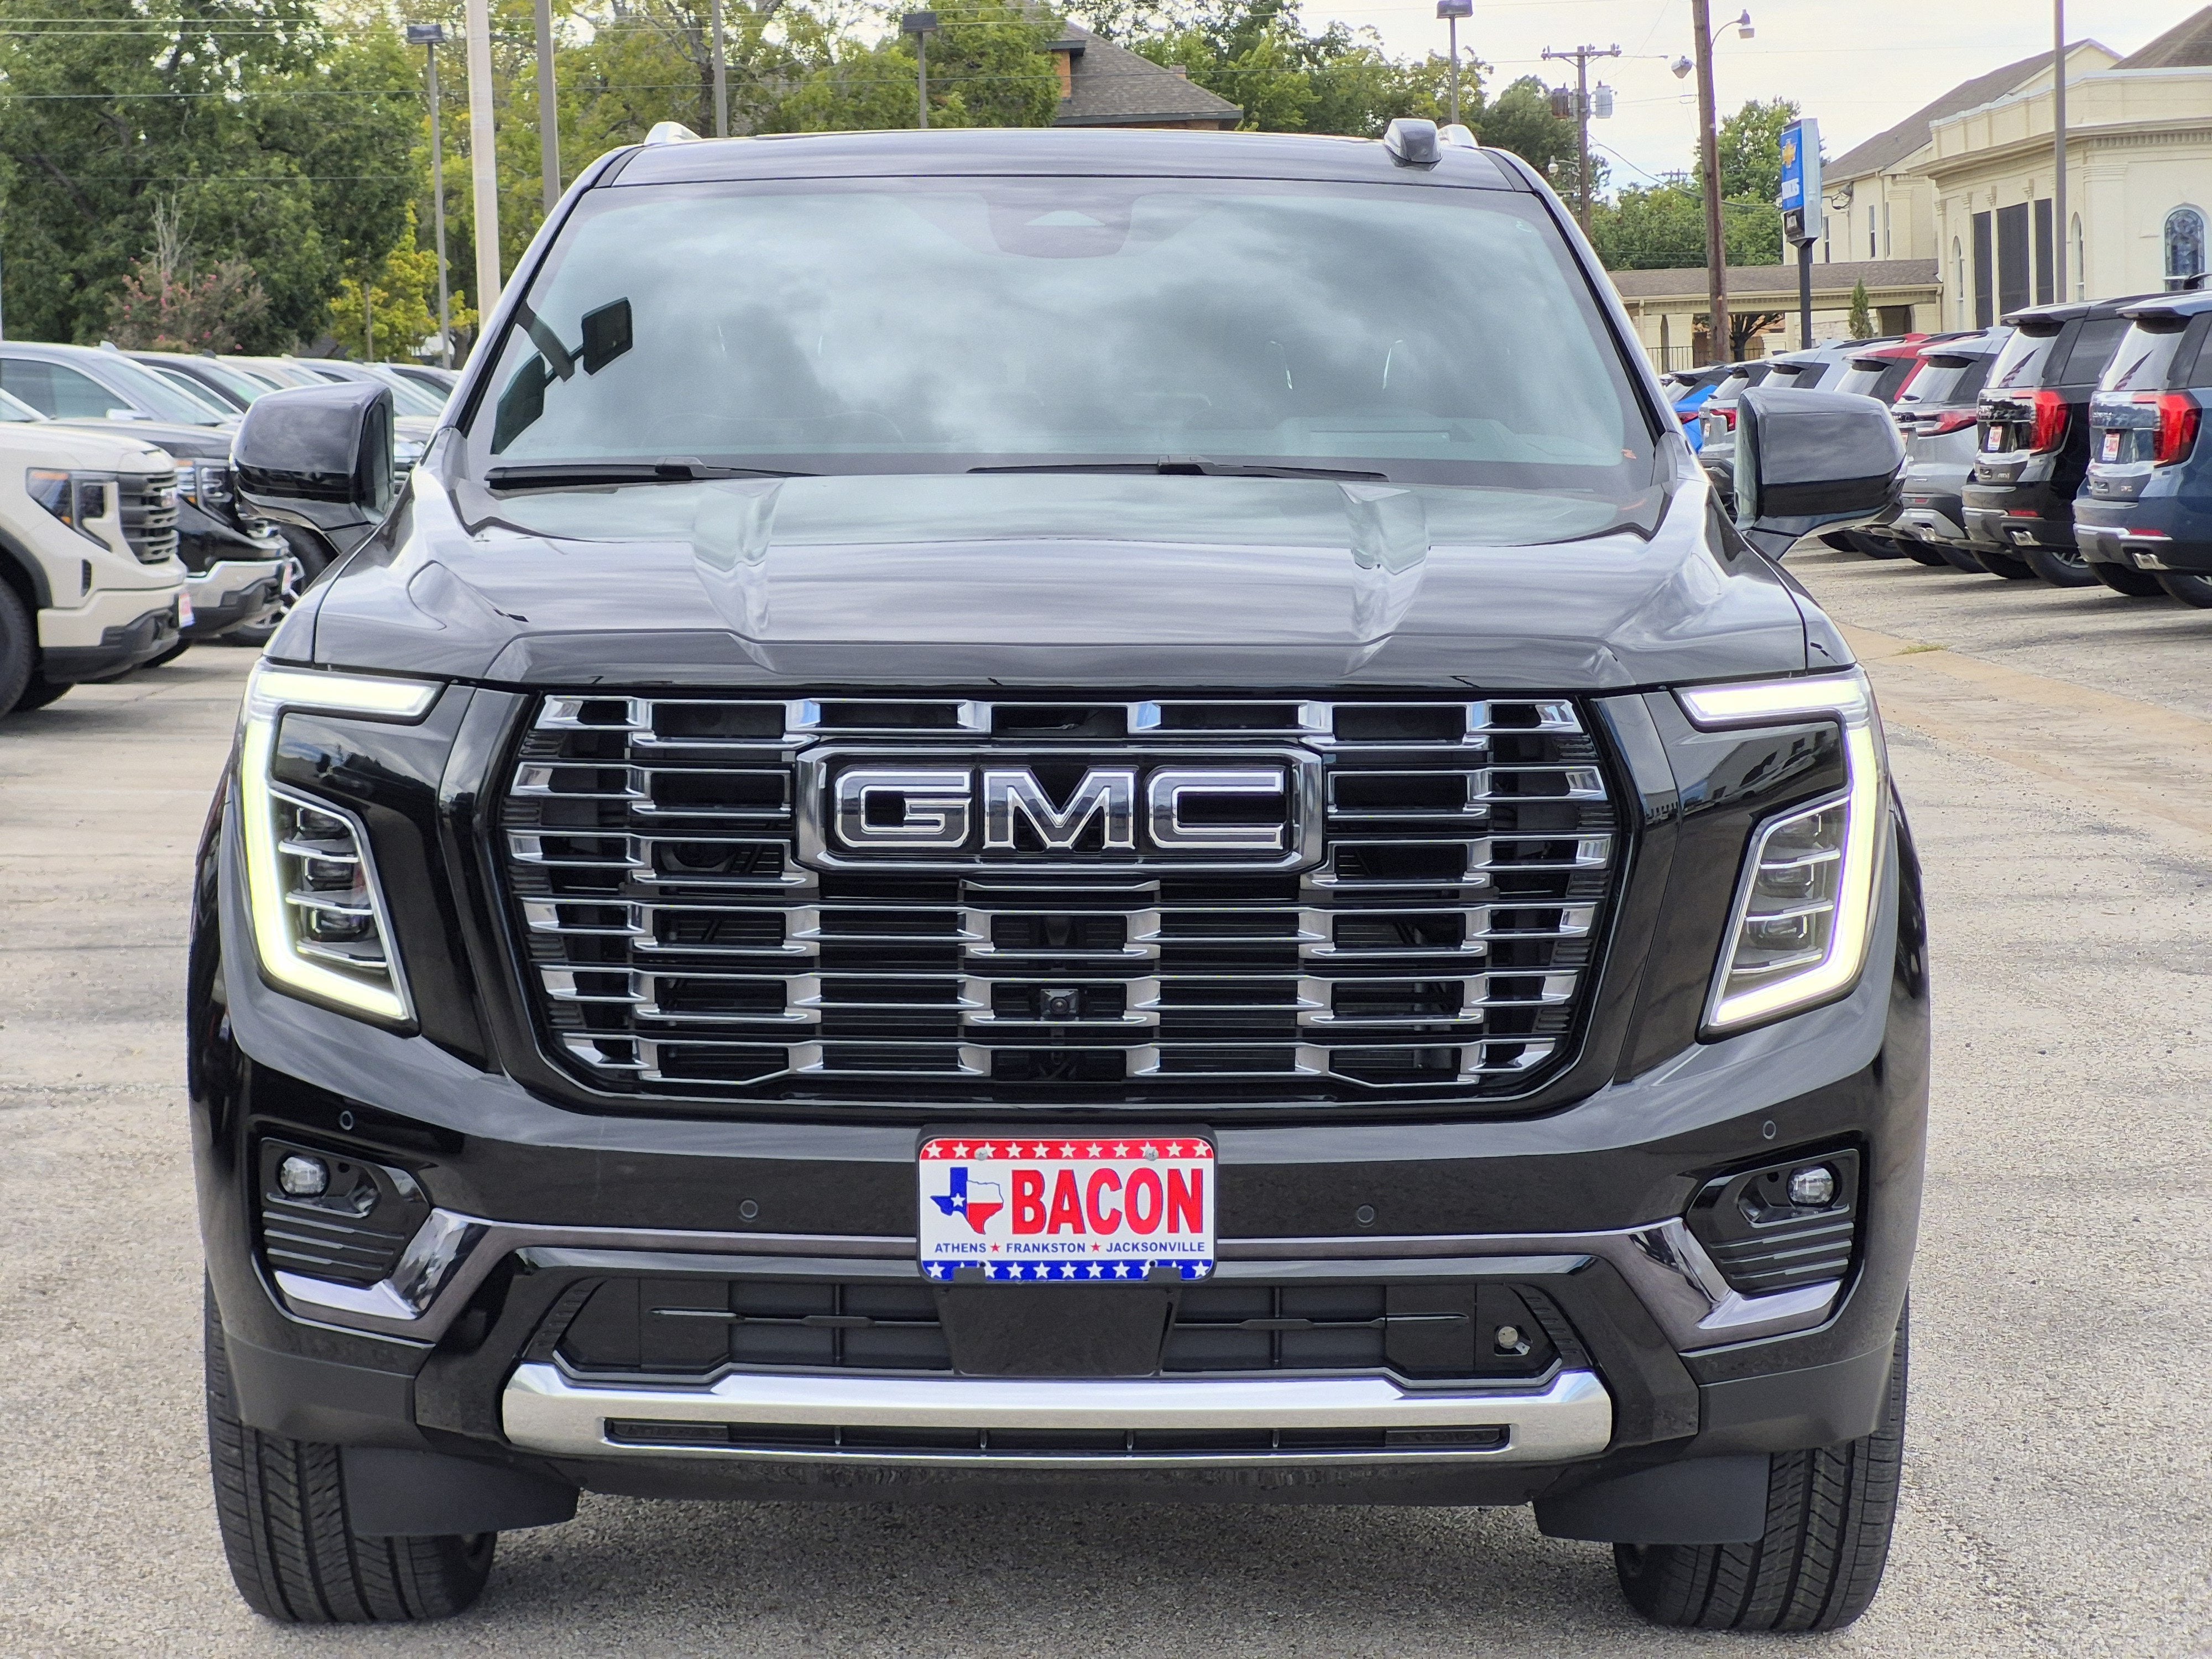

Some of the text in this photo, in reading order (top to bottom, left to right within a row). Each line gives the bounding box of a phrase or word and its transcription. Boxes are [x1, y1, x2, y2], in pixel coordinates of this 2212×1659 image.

[834, 765, 1287, 850] GMC
[1011, 1167, 1204, 1235] BACON
[935, 1241, 1205, 1253] ATHENS FRANKSTON JACKSONVILLE
